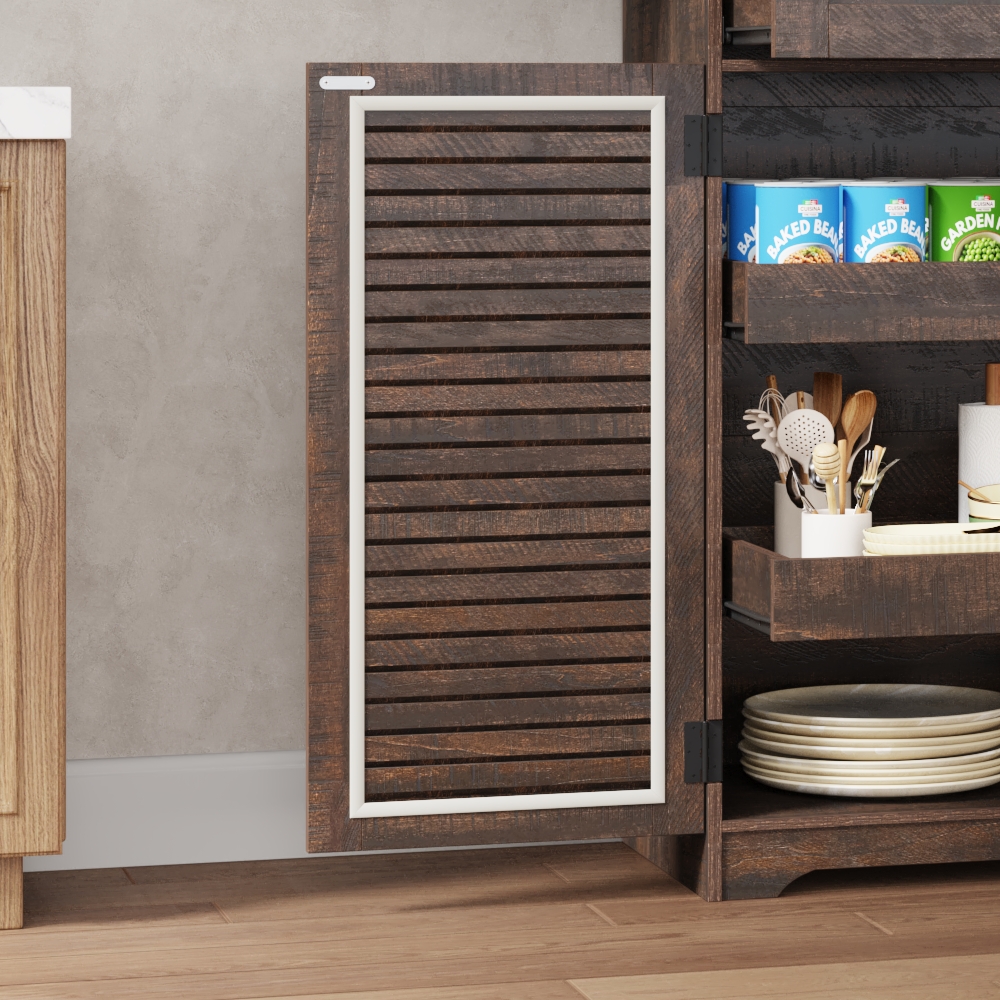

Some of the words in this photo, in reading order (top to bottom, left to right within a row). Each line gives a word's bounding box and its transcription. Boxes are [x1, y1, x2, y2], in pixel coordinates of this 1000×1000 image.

[737, 222, 756, 256] BAK
[766, 219, 811, 260] BAKED
[813, 218, 838, 258] BEAN
[853, 218, 898, 259] BAKED
[900, 217, 925, 258] BEAN
[940, 213, 995, 251] GARDEN
